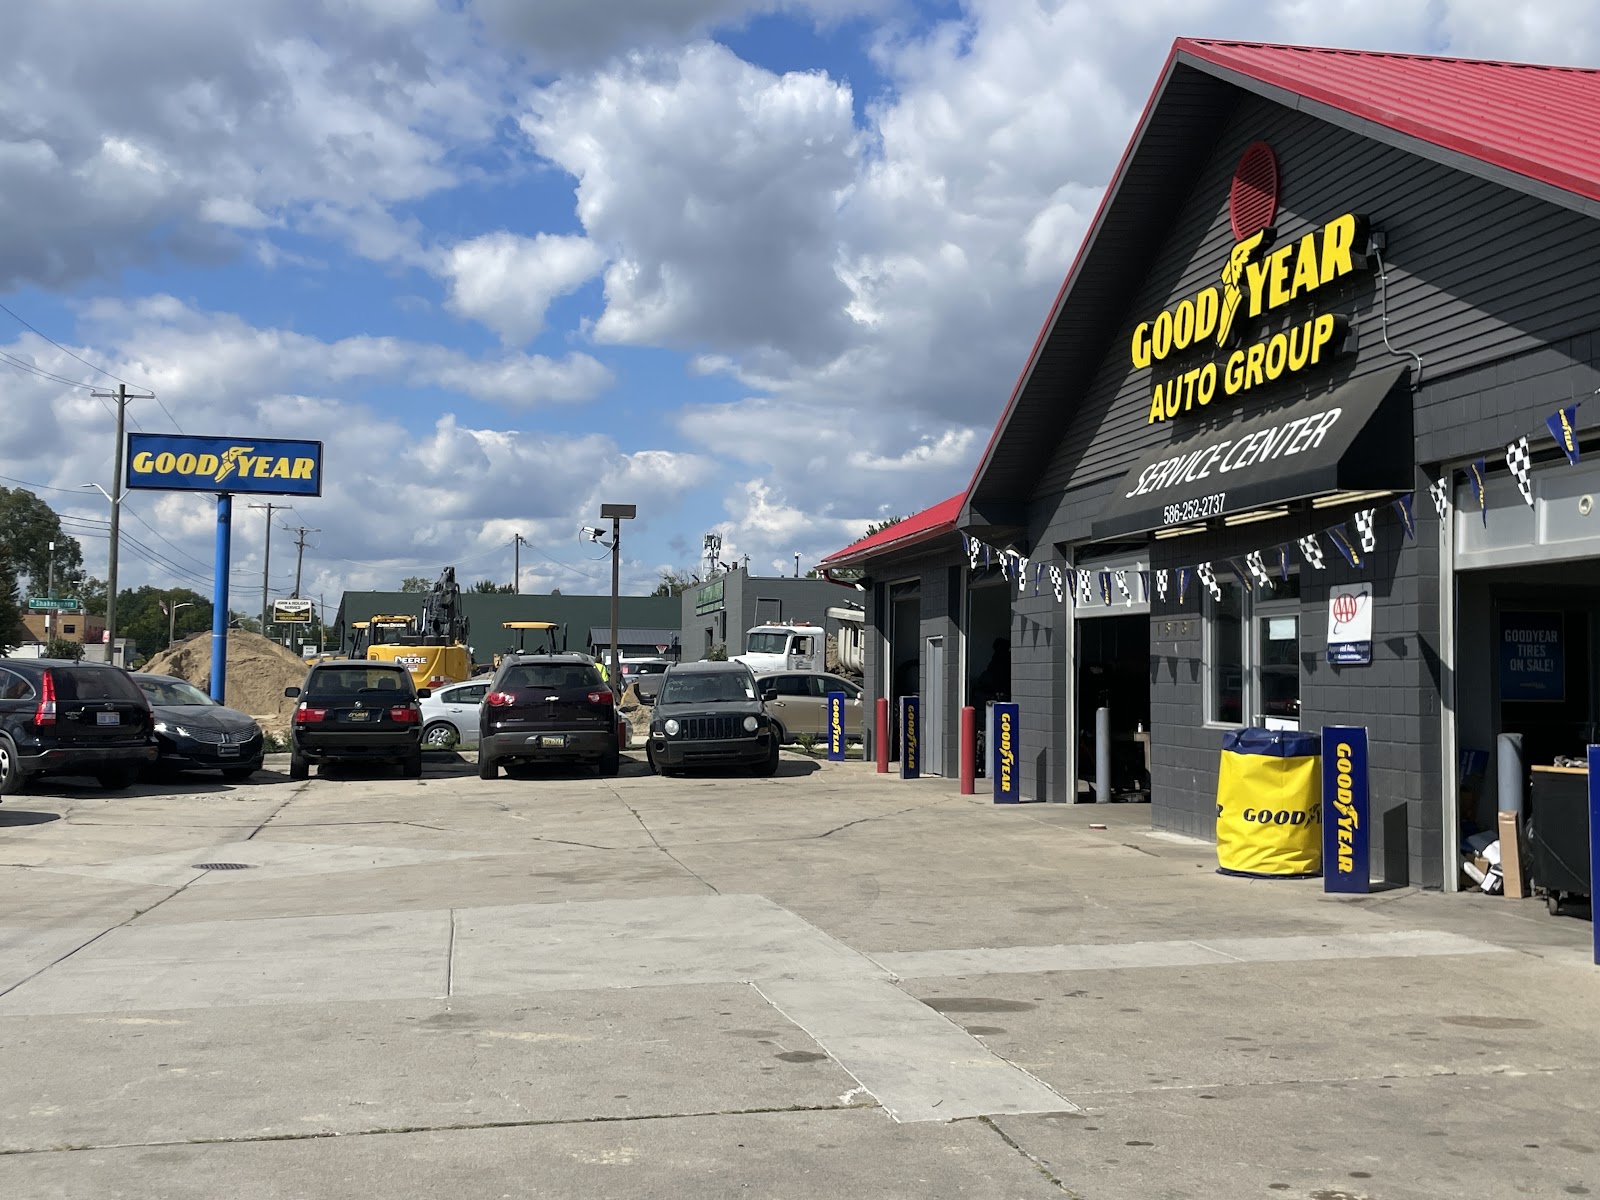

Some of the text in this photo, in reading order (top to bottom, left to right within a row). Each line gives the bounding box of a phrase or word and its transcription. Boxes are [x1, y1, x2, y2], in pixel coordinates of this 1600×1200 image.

[1131, 213, 1355, 369] GOODYEAR
[1148, 313, 1334, 424] AUTO GROUP
[132, 449, 315, 480] GOODYEAR
[1125, 407, 1342, 499] SERVICE CENTER
[1163, 493, 1226, 525] 586-252-2737
[1334, 594, 1356, 623] AAA
[1504, 629, 1558, 643] GOODYEAR
[1516, 644, 1546, 657] TIRES
[395, 656, 427, 664] DEERE
[1510, 658, 1554, 672] ON SALE!
[832, 698, 842, 754] GOODYEAR
[907, 704, 917, 769] GOODYEAR
[1001, 712, 1014, 792] GOODYEAR
[1335, 742, 1360, 874] GOODYEAR
